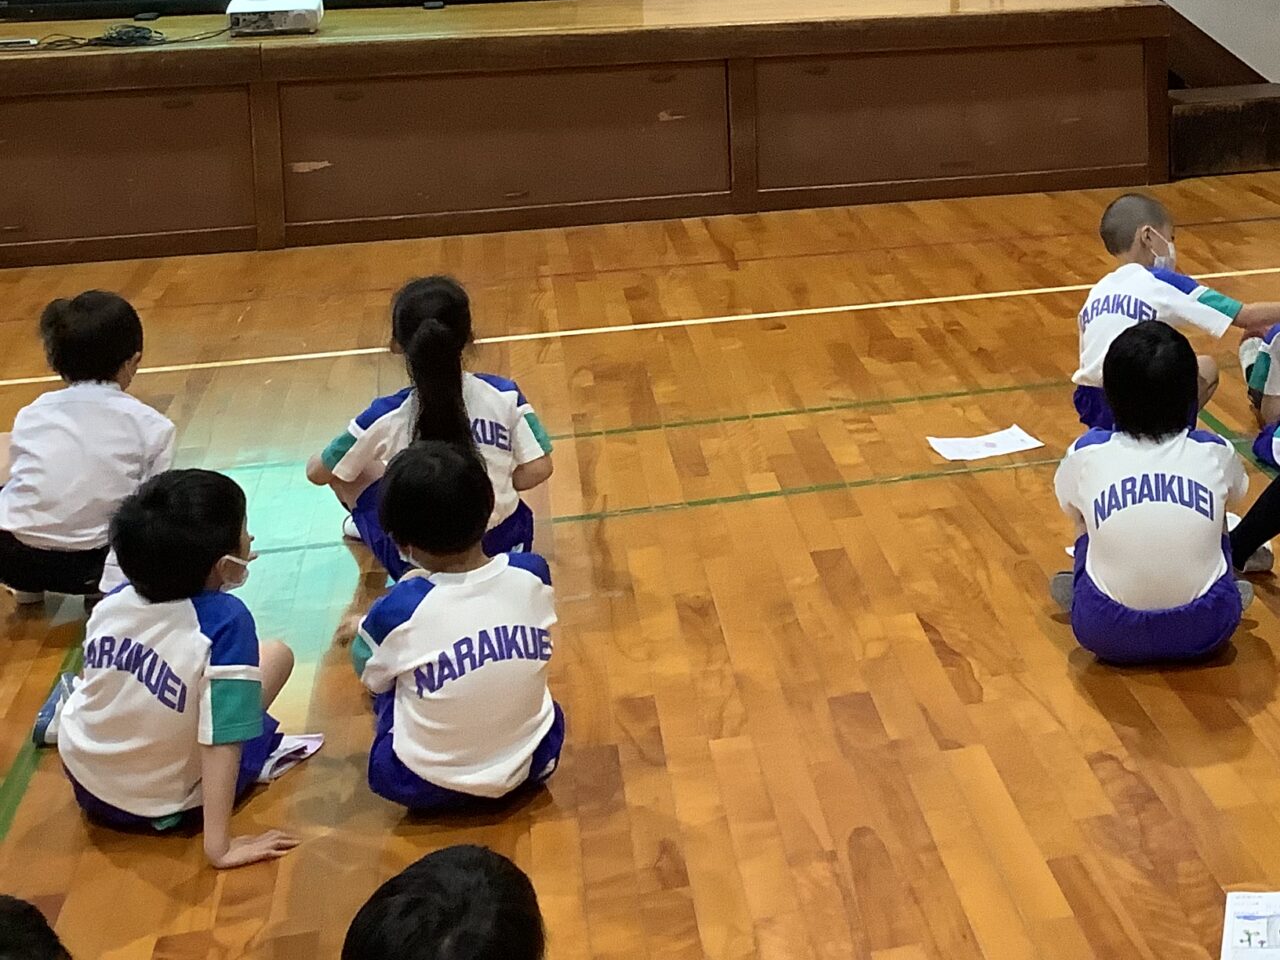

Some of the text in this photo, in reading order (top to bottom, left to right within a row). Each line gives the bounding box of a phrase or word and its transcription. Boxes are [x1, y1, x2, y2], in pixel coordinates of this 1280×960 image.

[1079, 294, 1157, 331] ARAIKUEI
[1093, 473, 1215, 530] NARAIKUEI
[84, 635, 187, 713] ARAIKUEI
[413, 624, 553, 698] NARAIKUE
